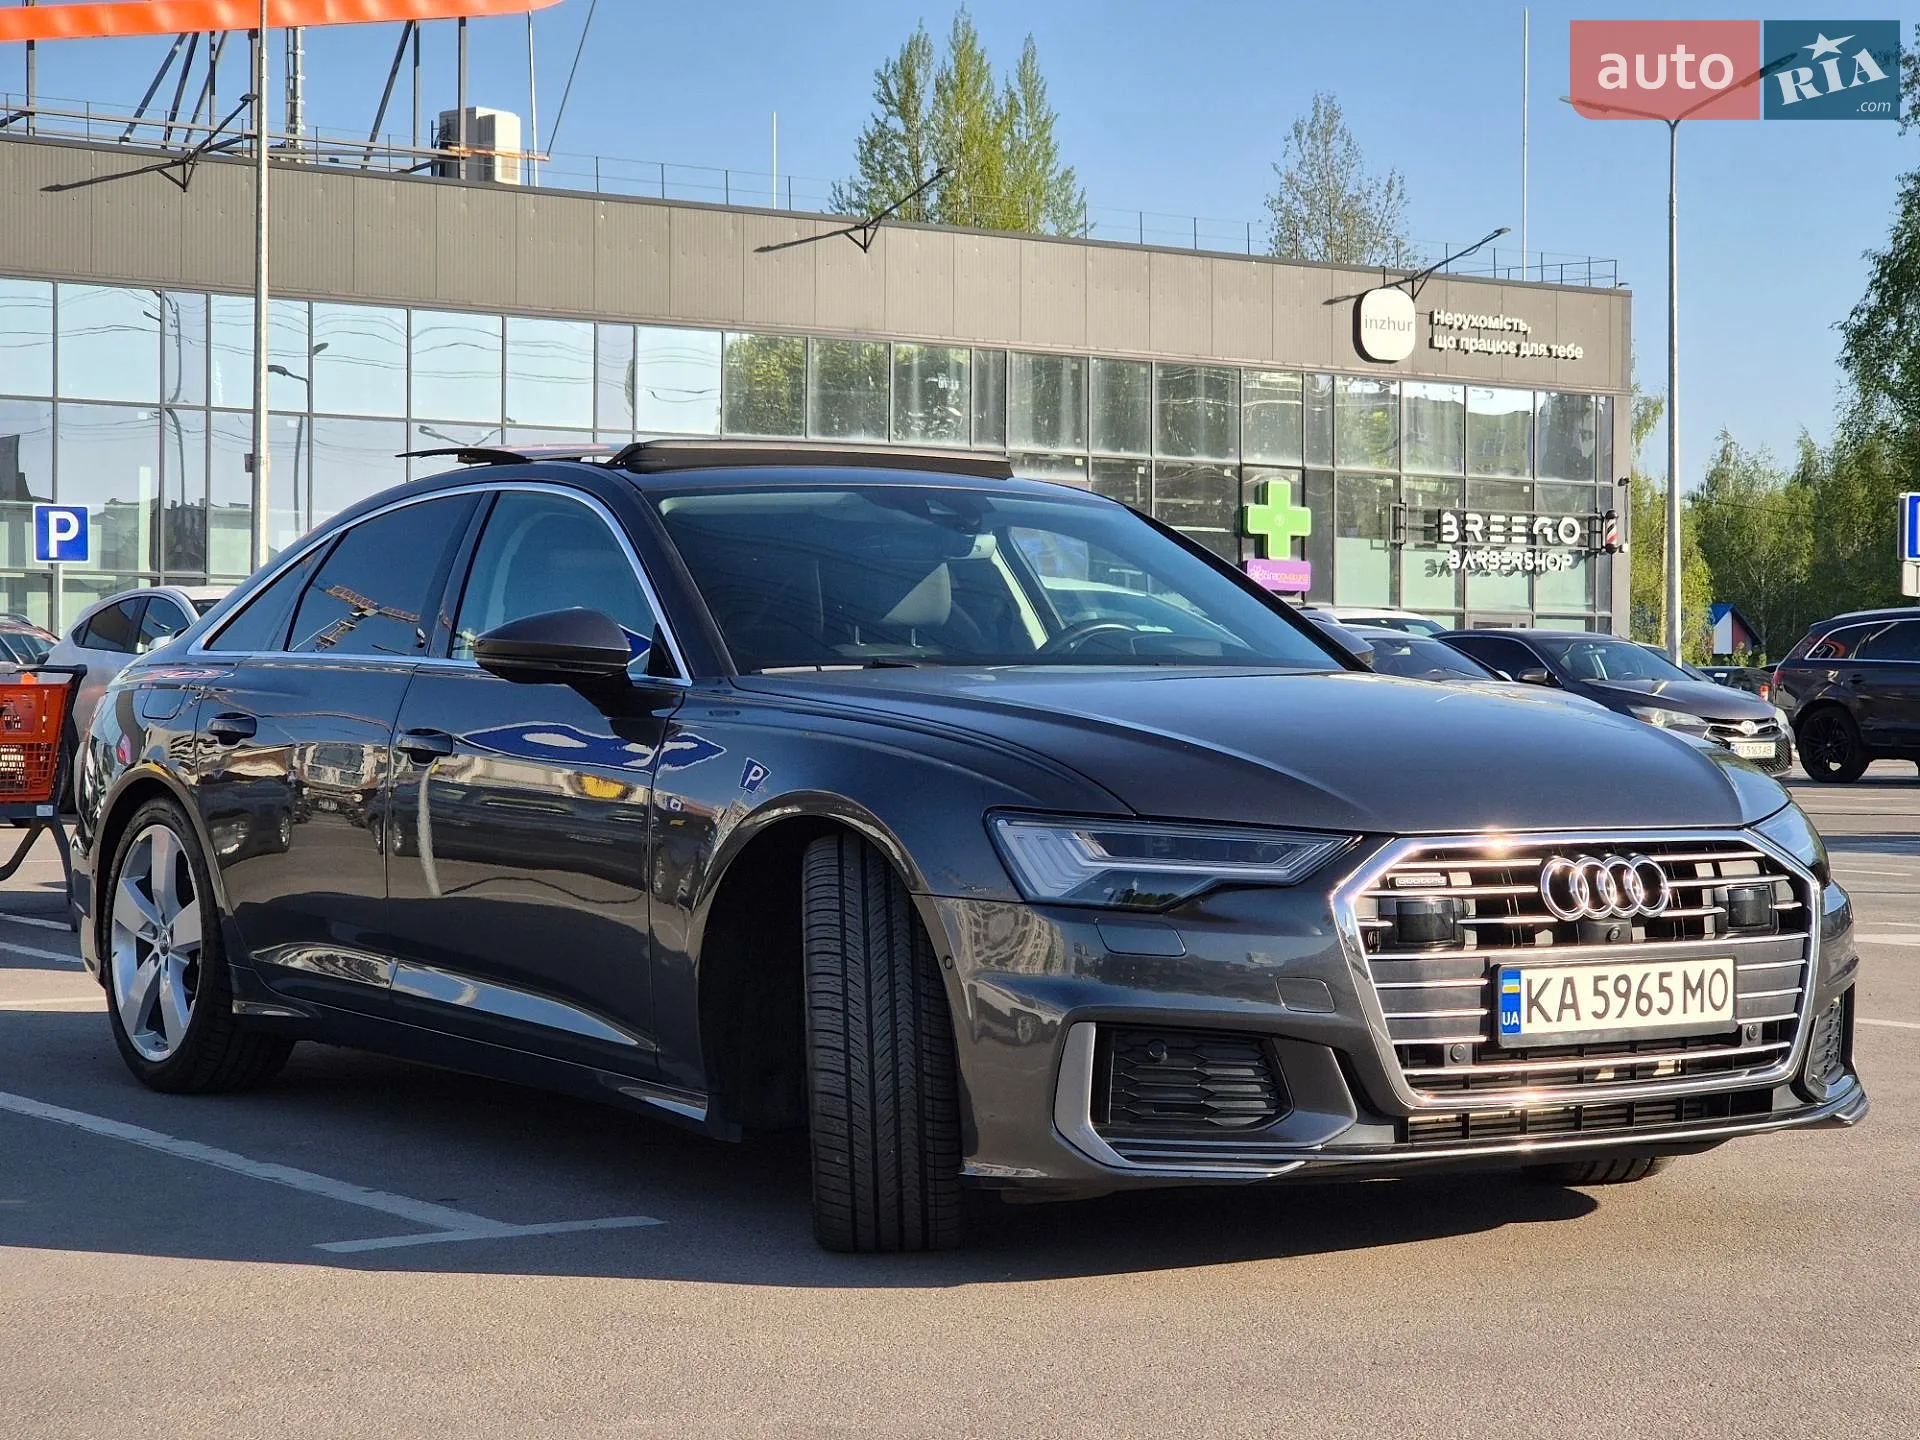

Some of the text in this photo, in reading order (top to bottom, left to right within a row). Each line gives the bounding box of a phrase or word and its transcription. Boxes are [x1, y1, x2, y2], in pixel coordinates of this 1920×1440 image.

[1364, 314, 1413, 333] inzhur
[1459, 336, 1517, 356] працює
[1520, 341, 1549, 357] для
[1550, 343, 1584, 359] тебе
[48, 510, 80, 558] P
[1441, 511, 1581, 545] BREEGO
[1449, 550, 1573, 572] BARBERSHOP
[1526, 967, 1728, 1024] KA 5965 MO
[1502, 1012, 1520, 1026] UA
